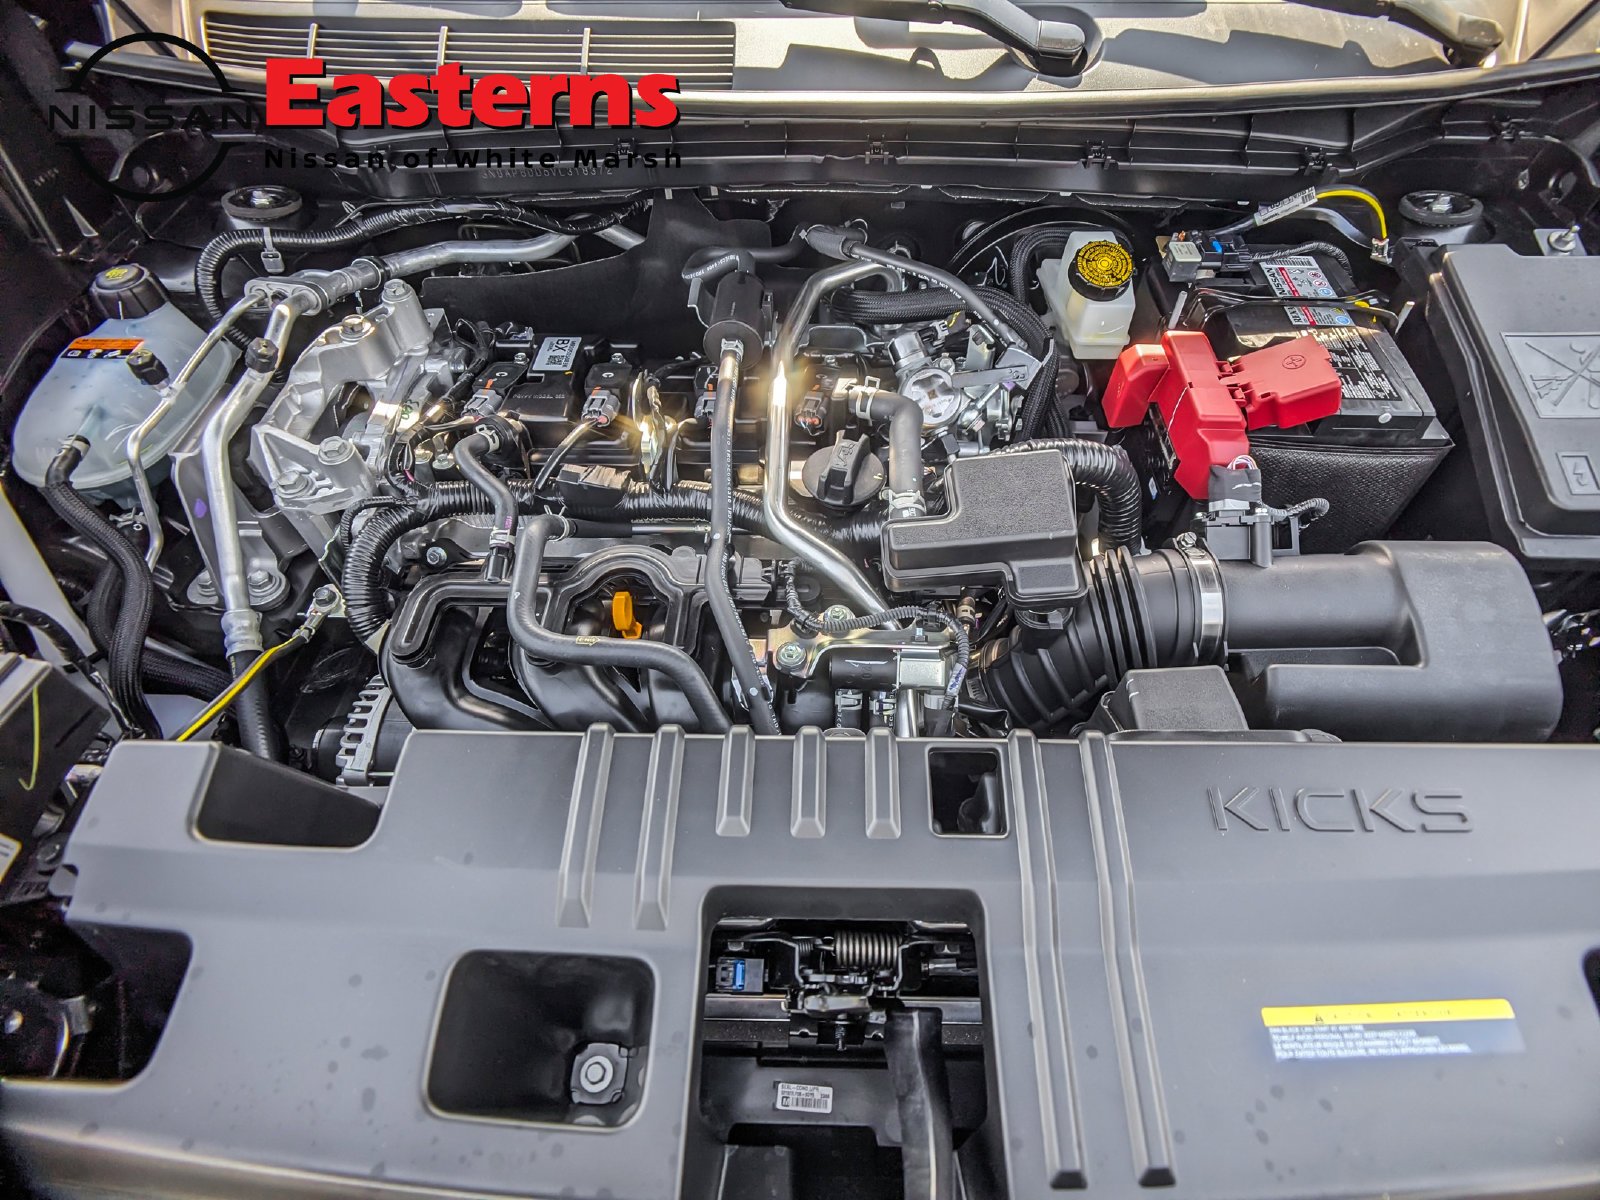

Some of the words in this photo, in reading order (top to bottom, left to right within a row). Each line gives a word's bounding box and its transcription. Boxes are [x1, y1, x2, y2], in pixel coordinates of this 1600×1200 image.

[1265, 266, 1288, 296] NISSAN
[552, 338, 570, 353] BX
[1206, 787, 1473, 833] KICKS
